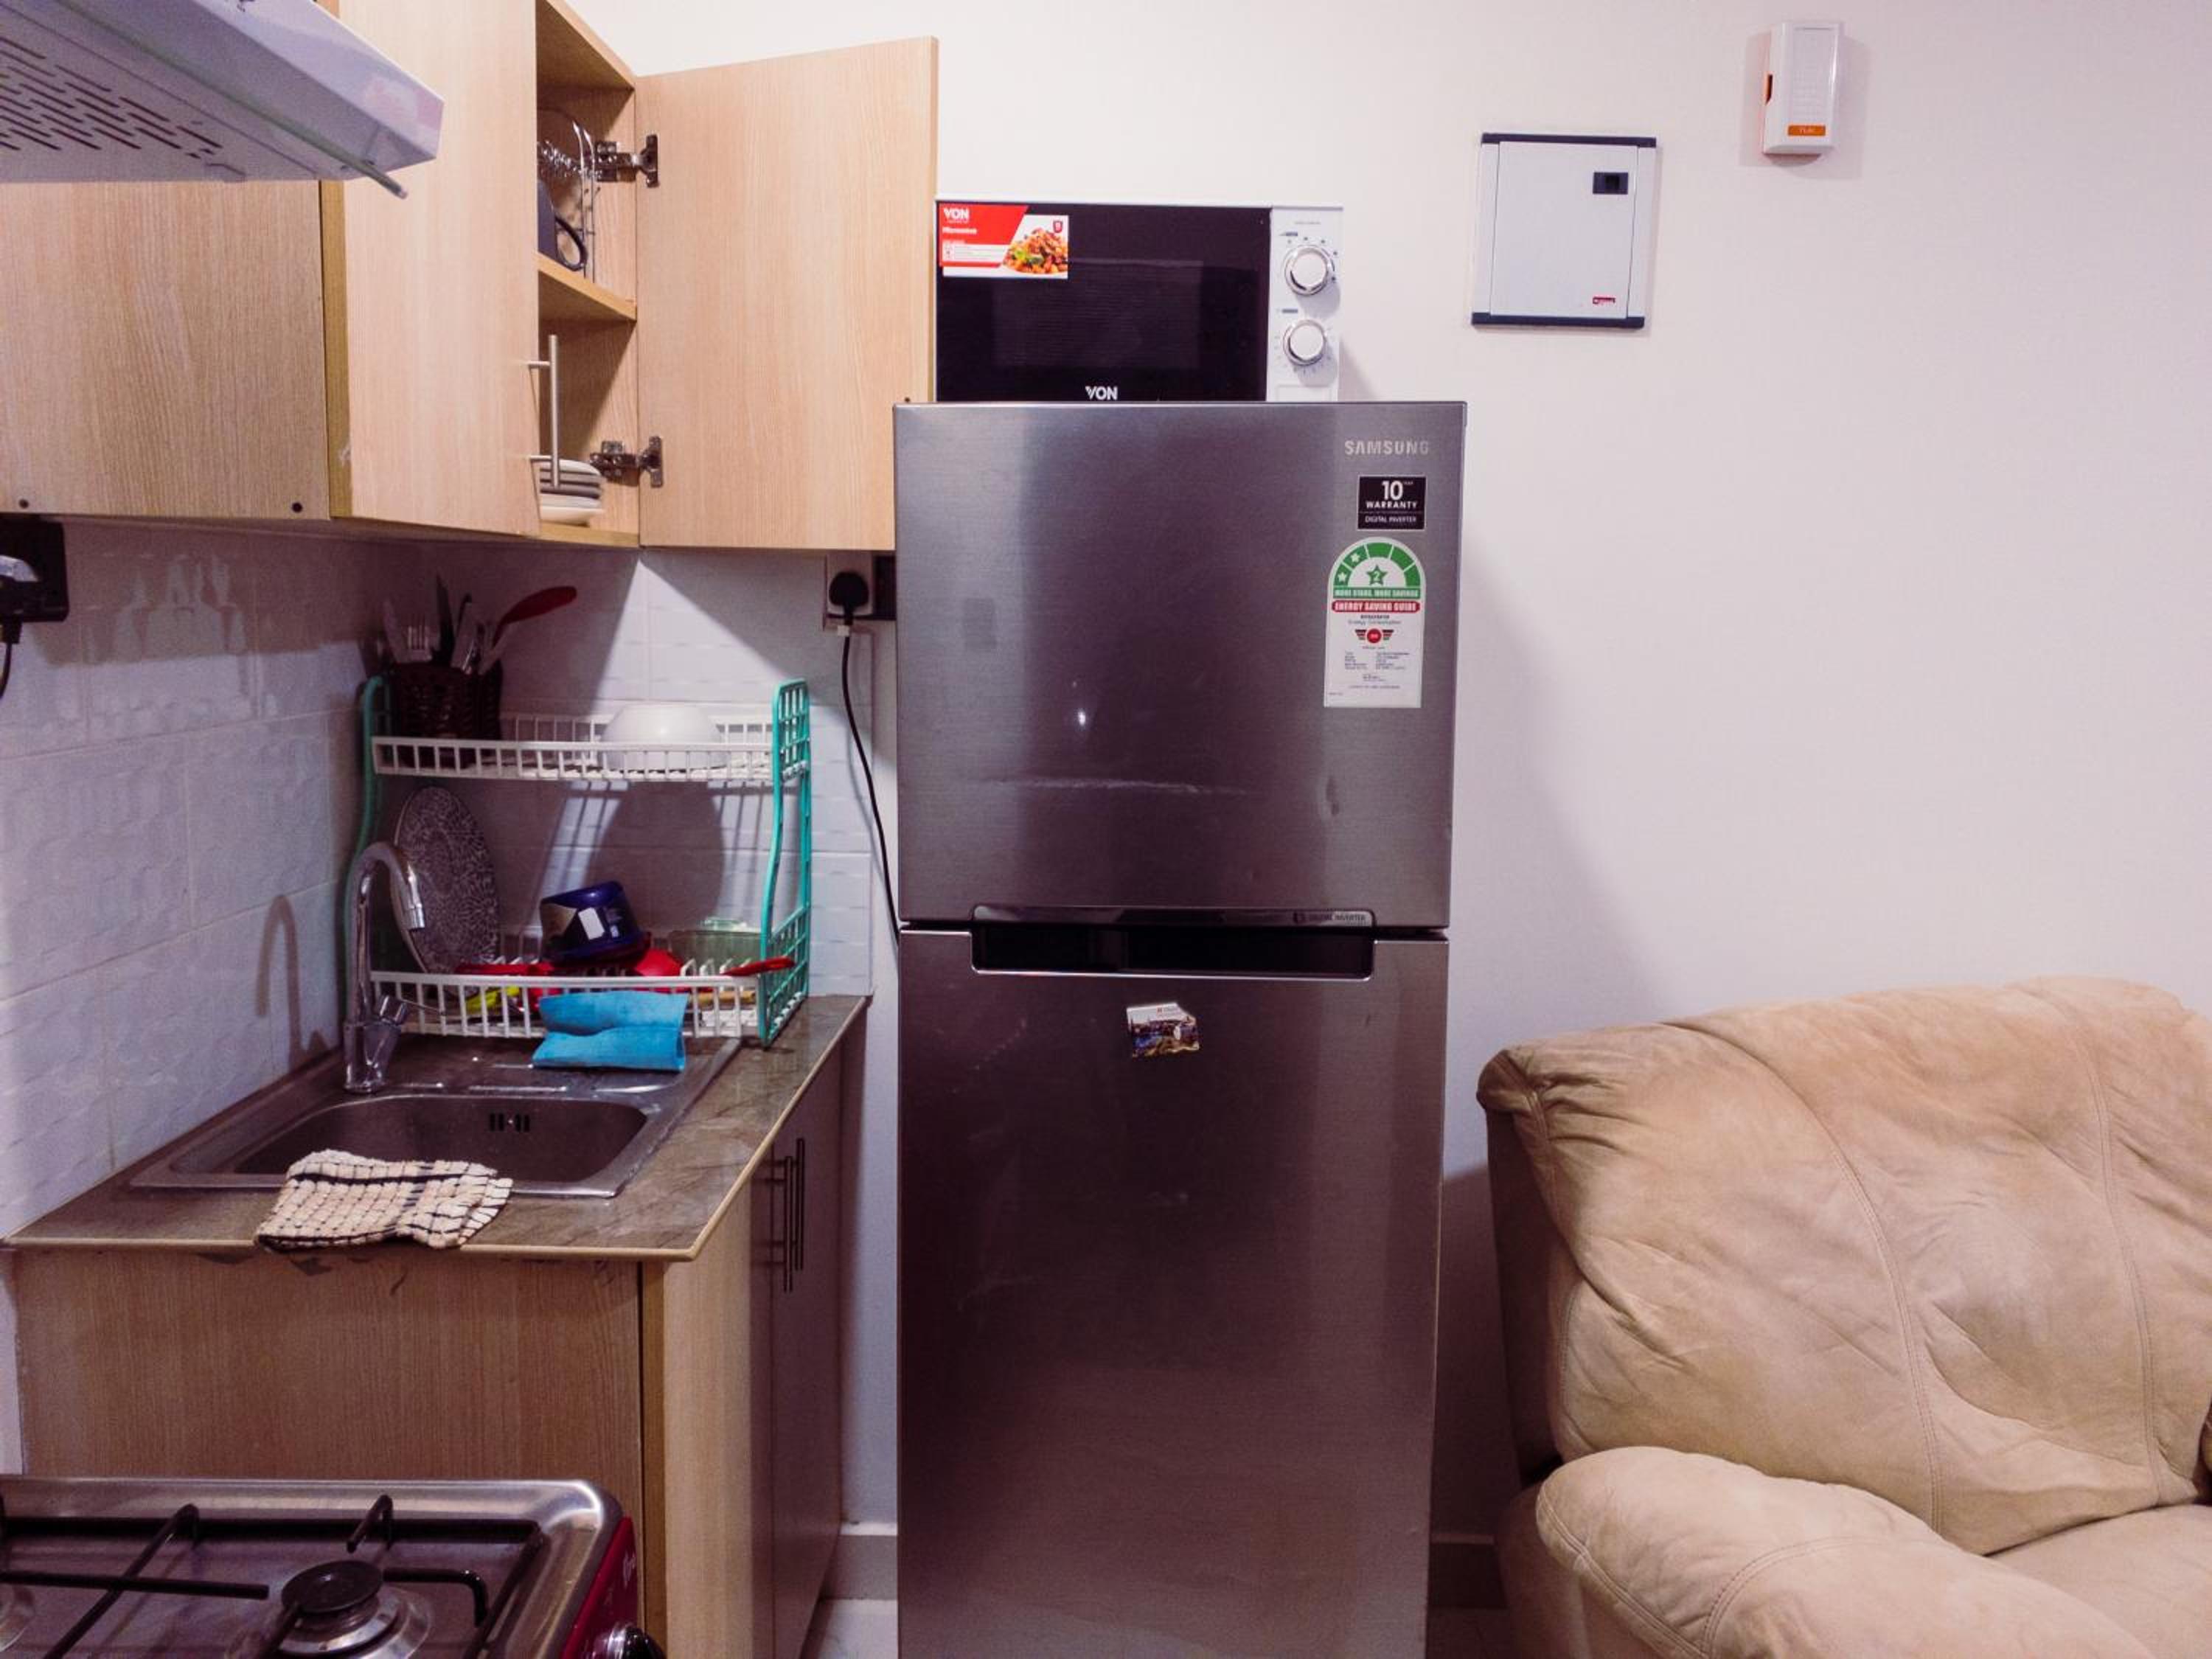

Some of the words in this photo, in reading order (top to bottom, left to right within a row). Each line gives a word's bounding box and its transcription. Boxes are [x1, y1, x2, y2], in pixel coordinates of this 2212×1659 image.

[943, 207, 970, 219] VON
[1085, 386, 1118, 400] VON
[1344, 440, 1429, 455] SAMSUNG
[1382, 480, 1403, 501] 10
[1366, 501, 1418, 509] WARRANTY
[1335, 602, 1363, 611] ENERGY
[1364, 602, 1392, 611] SAVING
[1393, 602, 1417, 611] GUIDE
